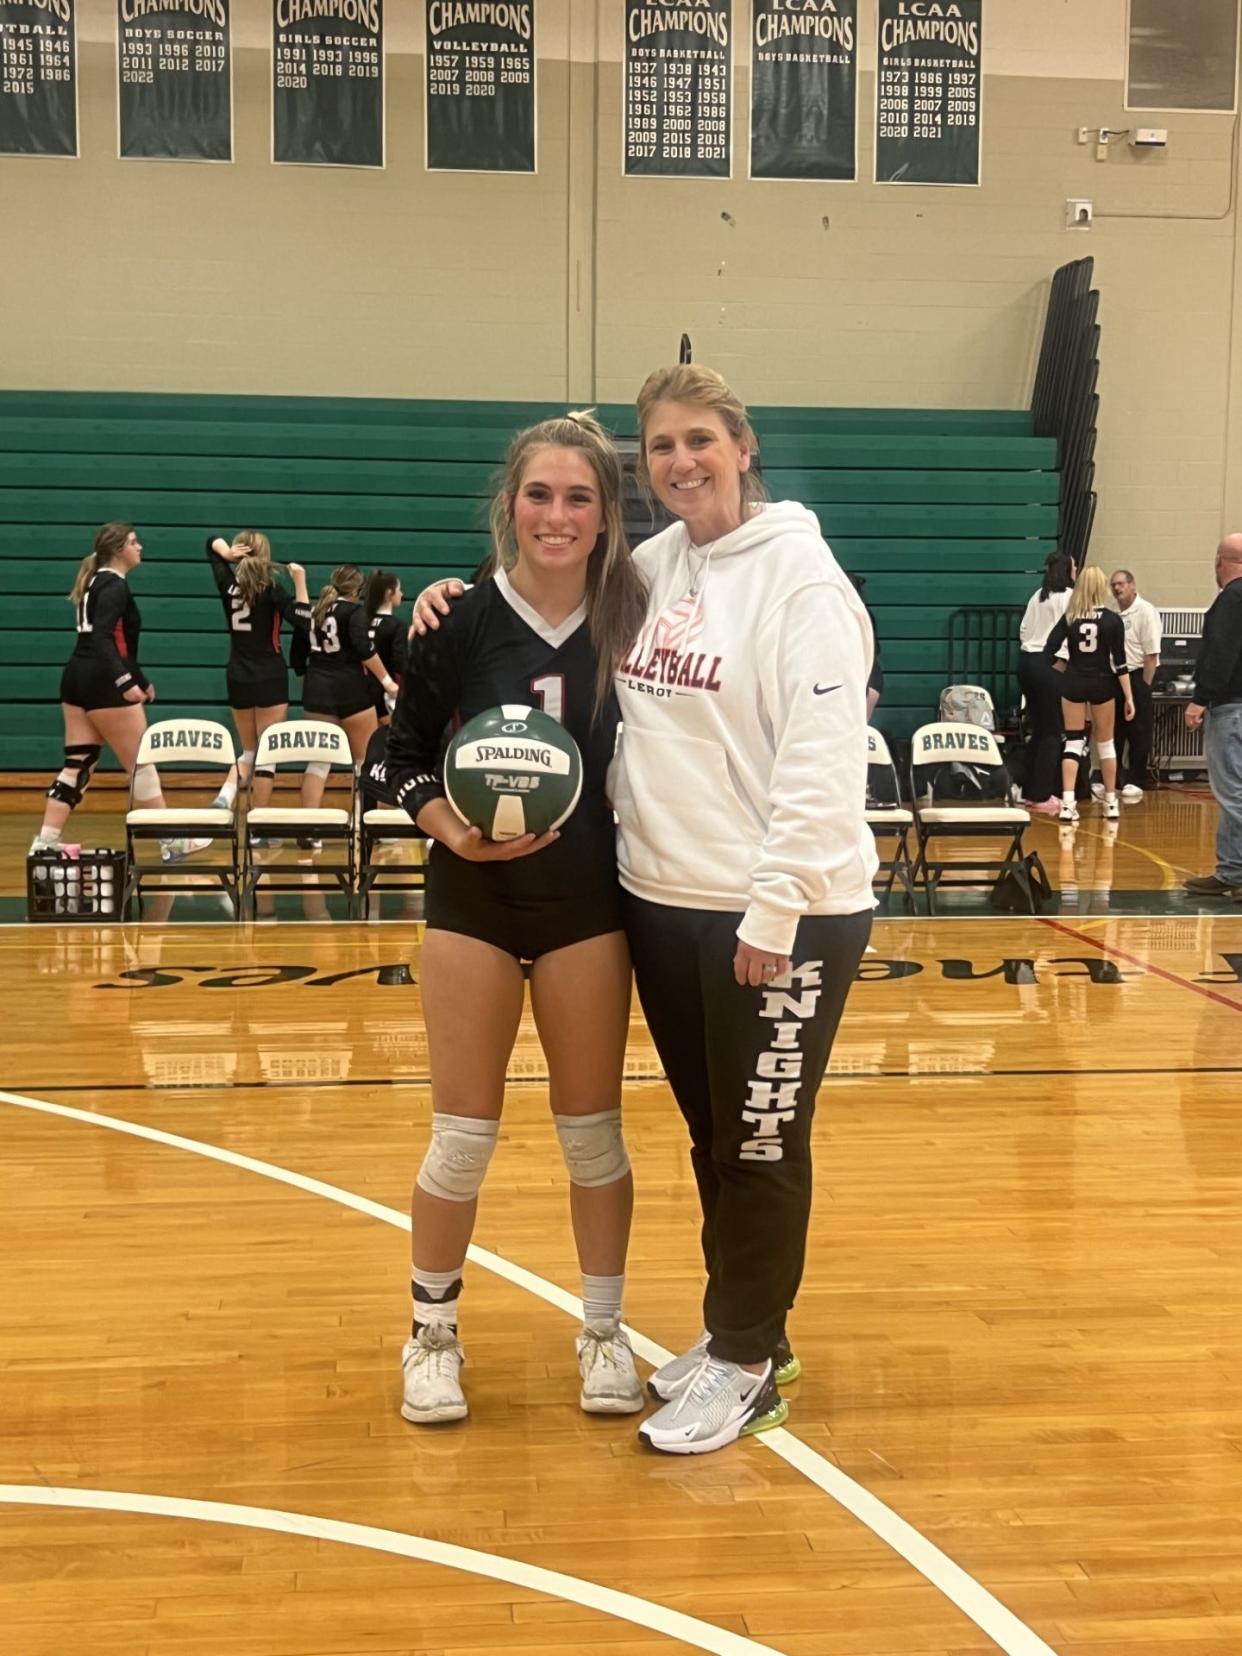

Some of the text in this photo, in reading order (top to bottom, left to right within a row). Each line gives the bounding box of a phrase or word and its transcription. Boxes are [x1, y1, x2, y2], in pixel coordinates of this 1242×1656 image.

[773, 0, 836, 11] LCAA
[899, 3, 961, 17] LCAA
[277, 0, 379, 33] CHAMPIONS
[430, 2, 530, 39] CHAMPIONS
[126, 29, 223, 40] BOYS SOCCER
[629, 9, 727, 46] CHAMPIONS
[756, 14, 853, 51] CHAMPIONS
[279, 34, 376, 46] GIRLS SOCCER
[882, 19, 977, 55] CHAMPIONS
[3, 37, 69, 52] 1945 1946
[123, 43, 224, 57] 1993 1996 2010
[434, 41, 527, 52] VOLLEYBALL
[4, 53, 69, 66] 1961 1964
[277, 48, 377, 63] 1991 1993 1996
[632, 48, 725, 59] BOYS BASKETBALL
[759, 52, 850, 64] BOYS BASKETBALL
[123, 57, 224, 71] 2011 2012 2017
[431, 55, 529, 69] 1957 1959 1965
[629, 62, 726, 76] 1937 1938 1943
[883, 57, 975, 68] GIRLS BASKETBALL
[4, 67, 70, 80] 1972 1986
[277, 62, 378, 77] 2014 2018 2019
[430, 69, 529, 83] 2007 2008 2009
[123, 71, 153, 83] 2022
[277, 76, 307, 88] 2020
[629, 76, 725, 90] 1946 1947 1951
[881, 71, 975, 84] 1973 1986 1997
[4, 81, 33, 93] 2015
[431, 83, 495, 96] 2019 2020
[881, 85, 975, 98] 1998 1999 2005
[629, 90, 726, 104] 1952 1953 1958
[629, 104, 726, 117] 1961 1962 1986
[881, 99, 975, 112] 2006 2007 2009
[629, 118, 725, 131] 1989 2000 2008
[880, 112, 975, 125] 2010 2014 2019
[629, 132, 725, 145] 2009 2015 2016
[880, 126, 941, 138] 2020 2021
[629, 145, 725, 158] 2017 2018 2021
[231, 599, 252, 632] 2
[309, 615, 341, 653] 13
[1079, 622, 1098, 653] 3
[628, 679, 673, 698] LEROY
[530, 673, 565, 726] 1
[150, 730, 223, 750] BRAVES
[268, 731, 341, 751] BRAVES
[922, 731, 990, 751] BRAVES
[476, 745, 552, 768] SPALDING
[738, 960, 823, 1162] KNIGHTS
